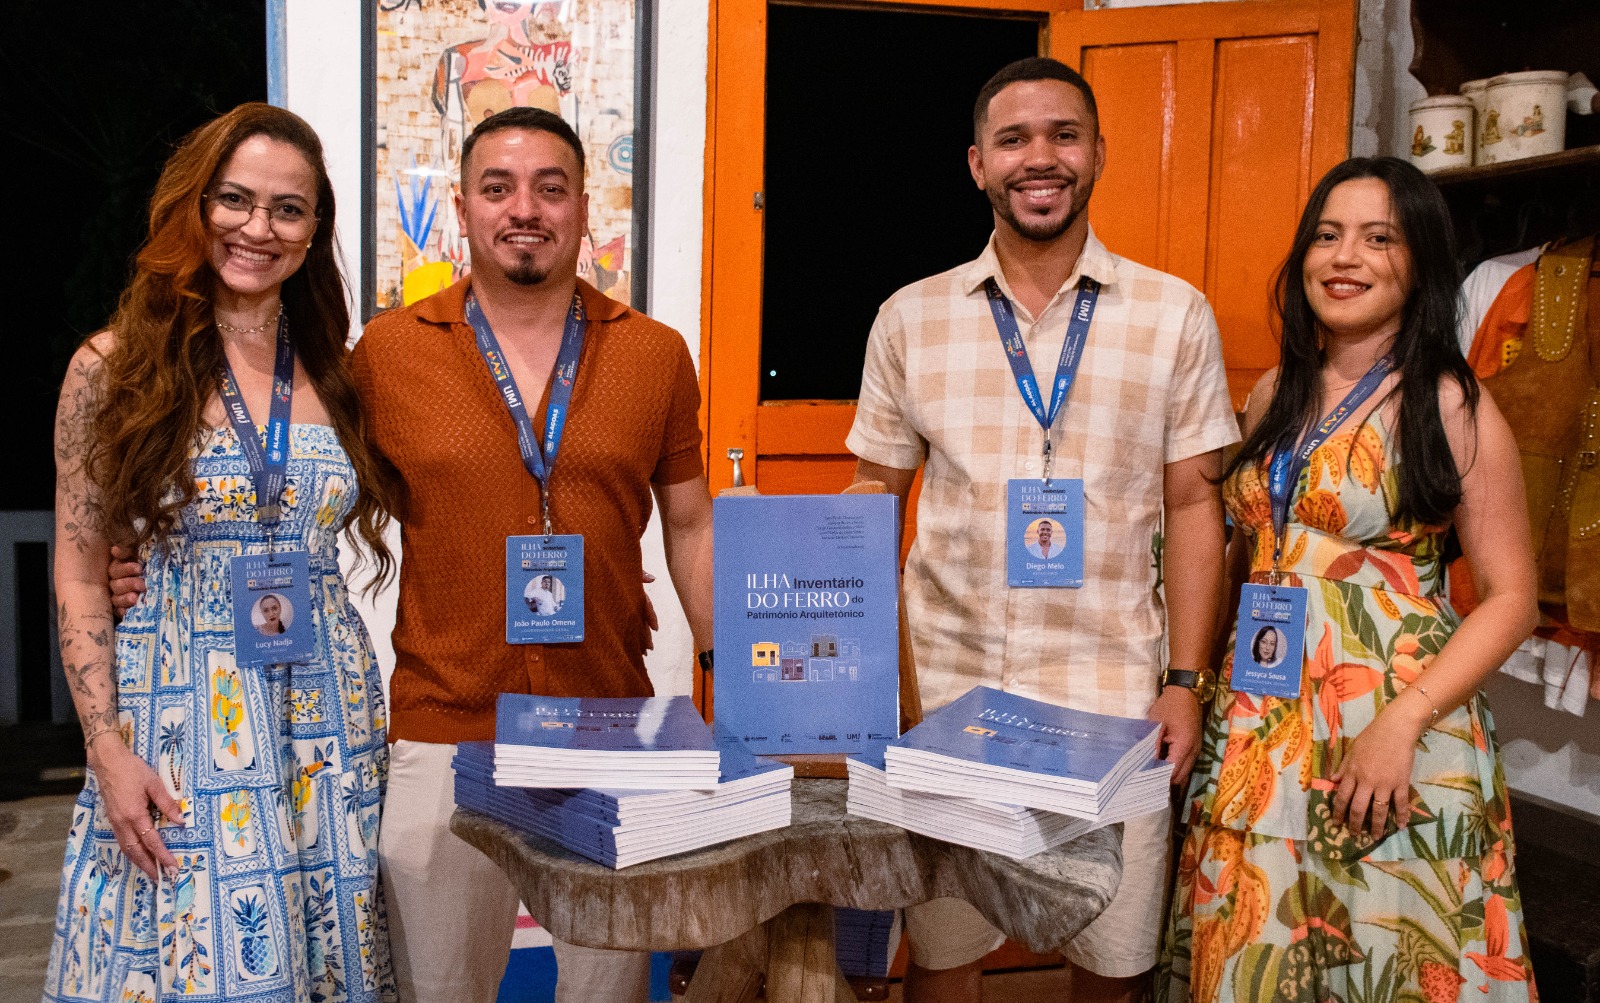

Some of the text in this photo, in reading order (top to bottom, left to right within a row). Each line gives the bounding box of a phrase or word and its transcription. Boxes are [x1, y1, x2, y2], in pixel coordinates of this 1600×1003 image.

[548, 408, 559, 439] ALAGOAS
[273, 422, 281, 449] ALAGOAS
[246, 561, 266, 570] ILHA
[246, 567, 294, 578] DO FERRO
[747, 573, 864, 589] ILHA Inventário
[747, 591, 864, 608] DO FERRO do
[1266, 602, 1292, 611] FERRO
[273, 638, 293, 647] Nadja
[1245, 670, 1286, 680] Jessyca Sousa
